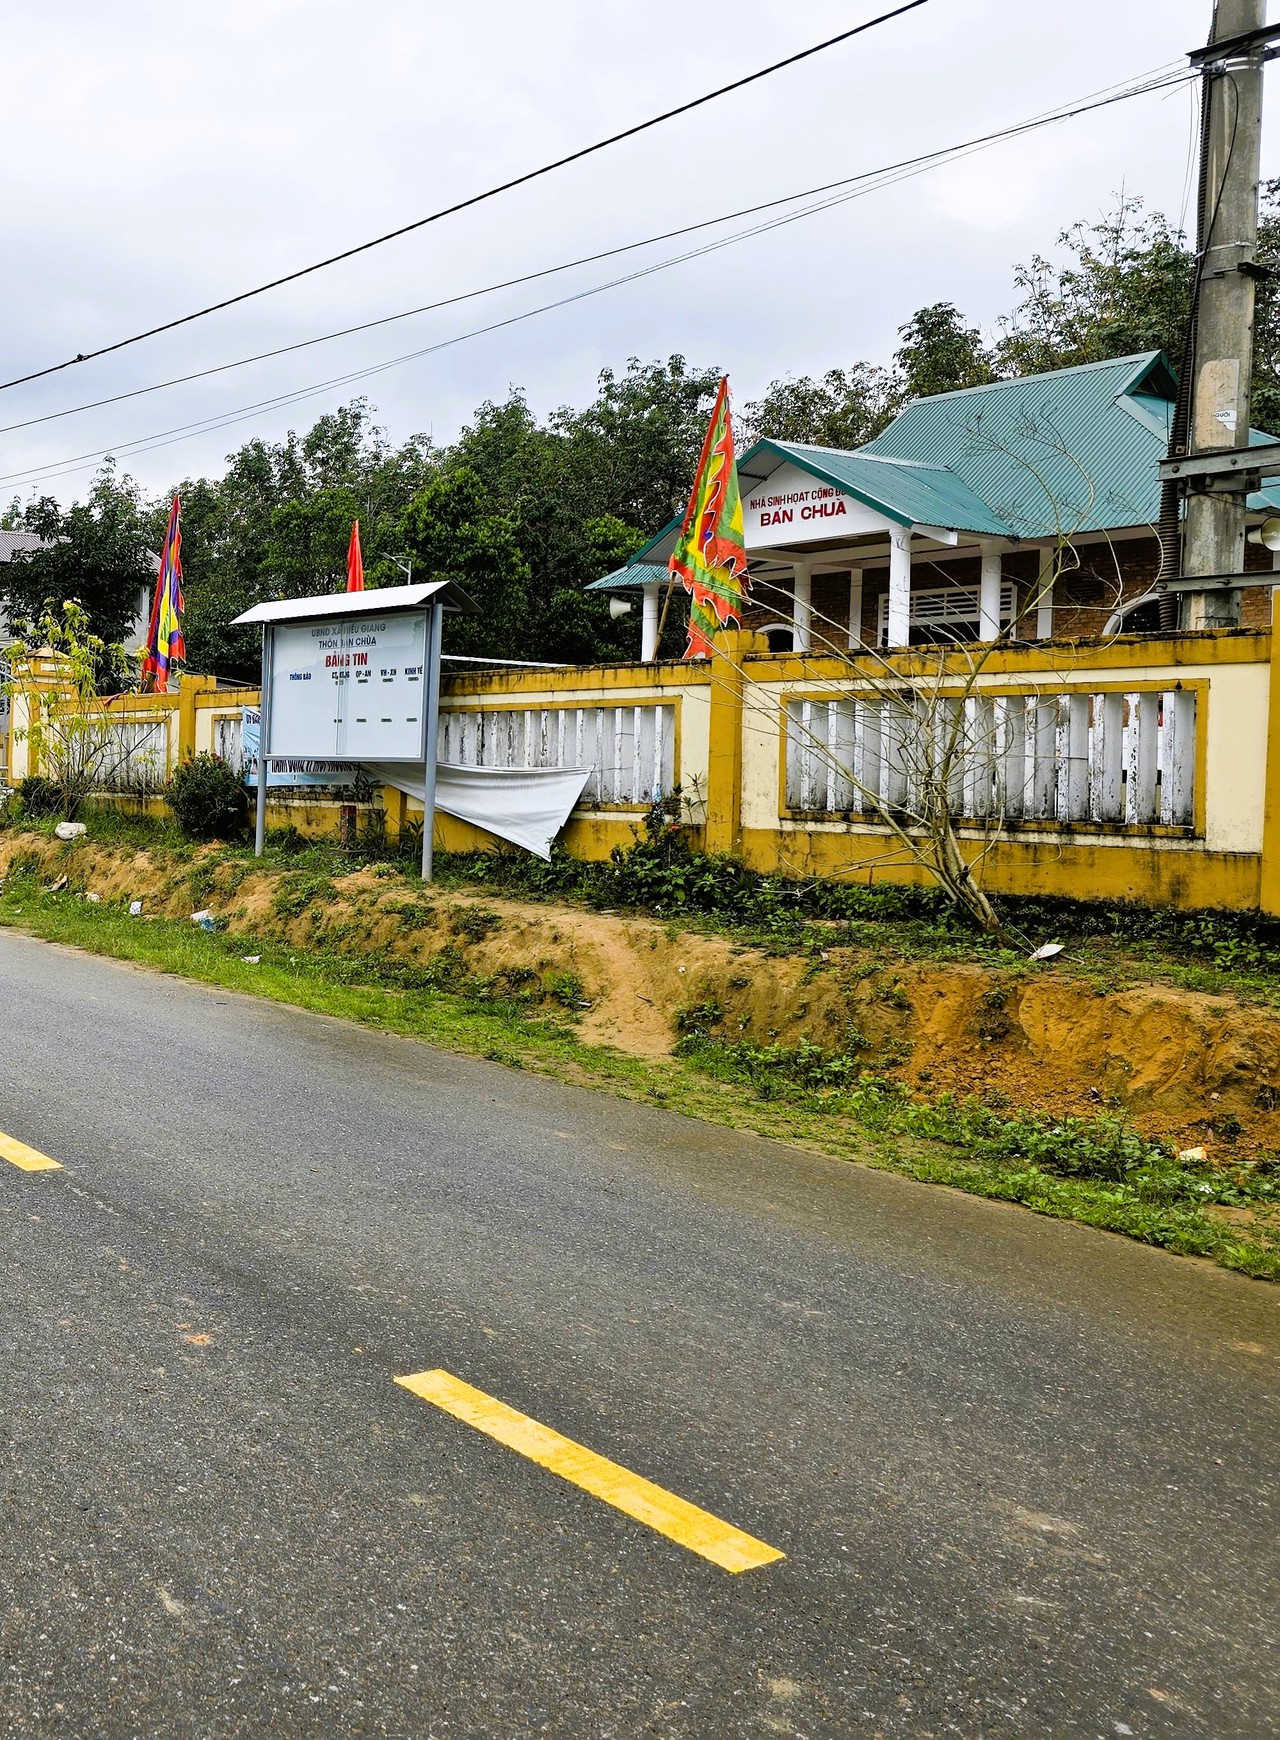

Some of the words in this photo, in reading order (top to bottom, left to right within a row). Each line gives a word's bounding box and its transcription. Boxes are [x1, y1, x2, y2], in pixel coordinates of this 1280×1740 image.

[767, 494, 786, 507] SINH
[311, 628, 330, 637] UBND
[361, 623, 386, 633] GIANG
[352, 653, 368, 666] TIN
